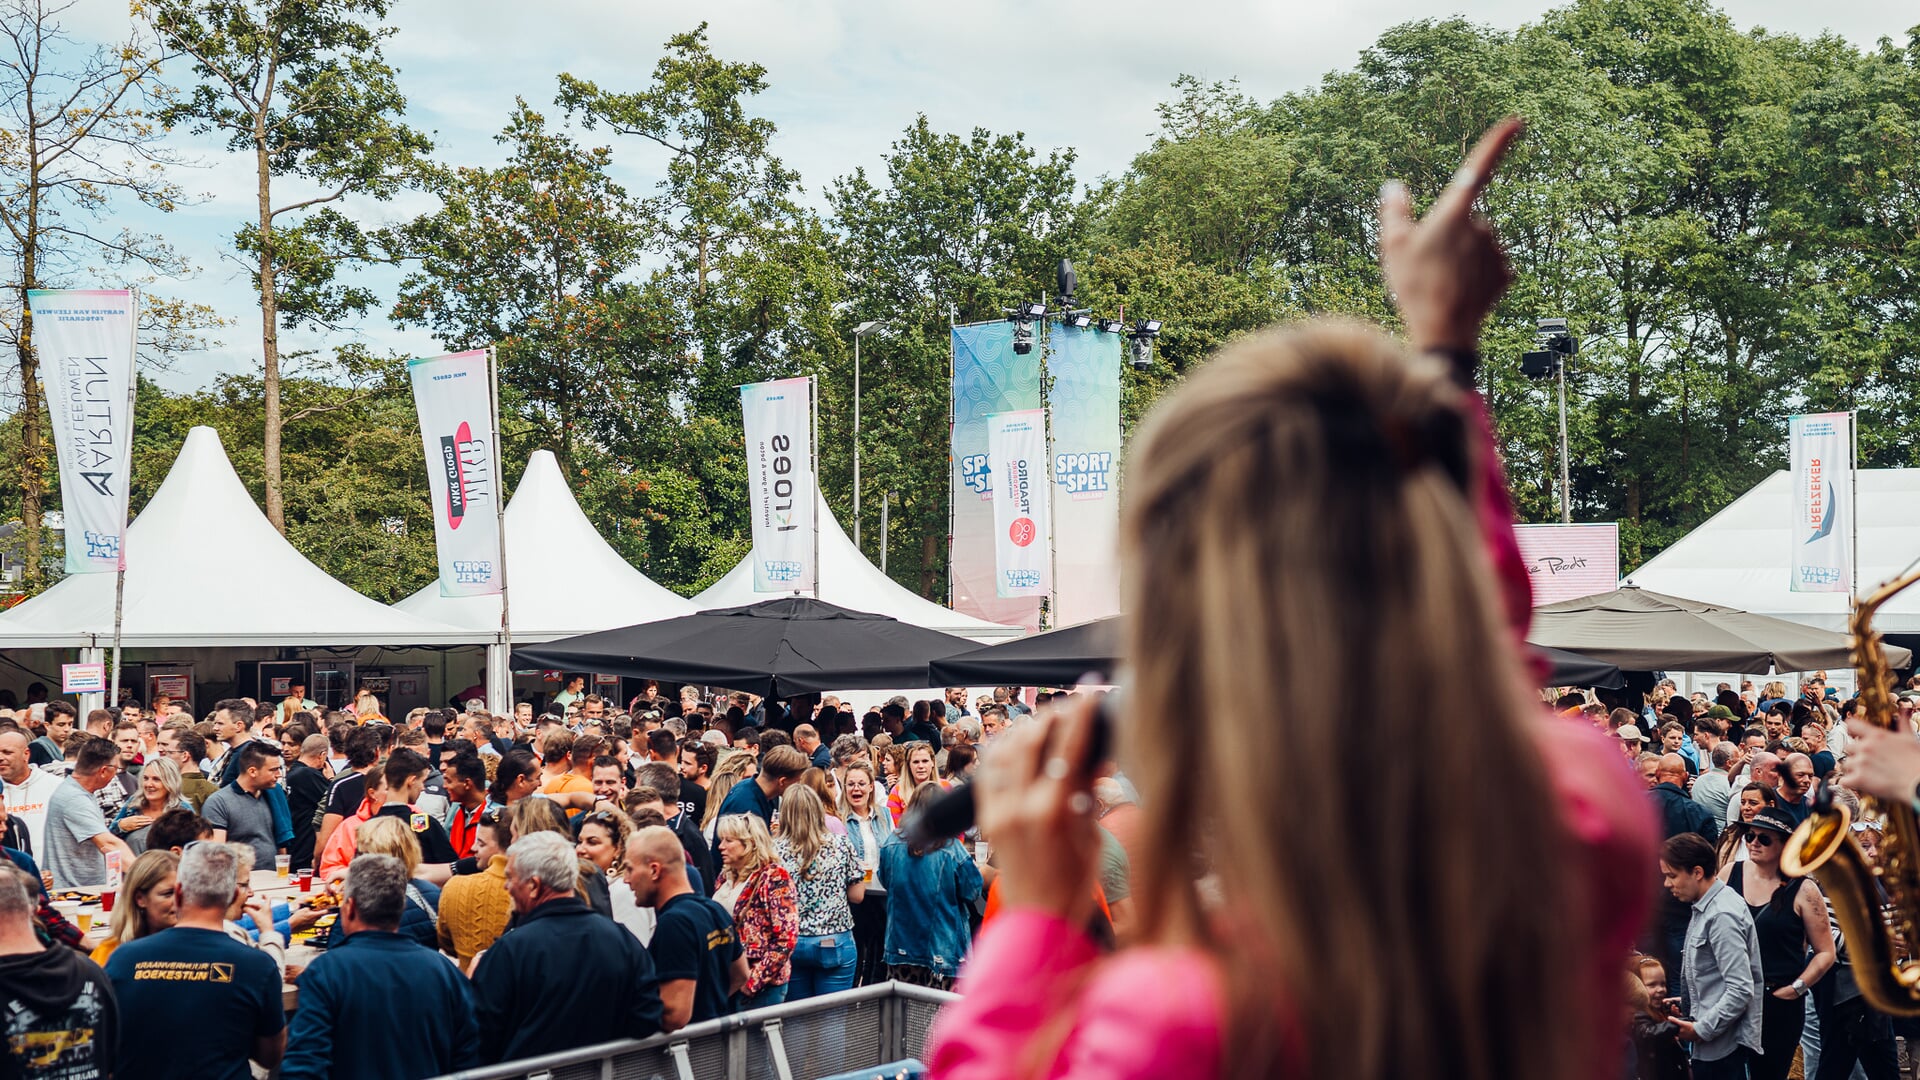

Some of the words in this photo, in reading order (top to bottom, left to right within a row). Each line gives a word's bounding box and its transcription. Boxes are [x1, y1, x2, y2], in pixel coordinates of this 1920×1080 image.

[1056, 453, 1111, 474] SPORT
[1066, 472, 1108, 493] SPEL
[1538, 556, 1587, 574] Poodt
[134, 962, 209, 970] KRAANVERHUUR
[134, 970, 209, 980] BOEKESTIJN
